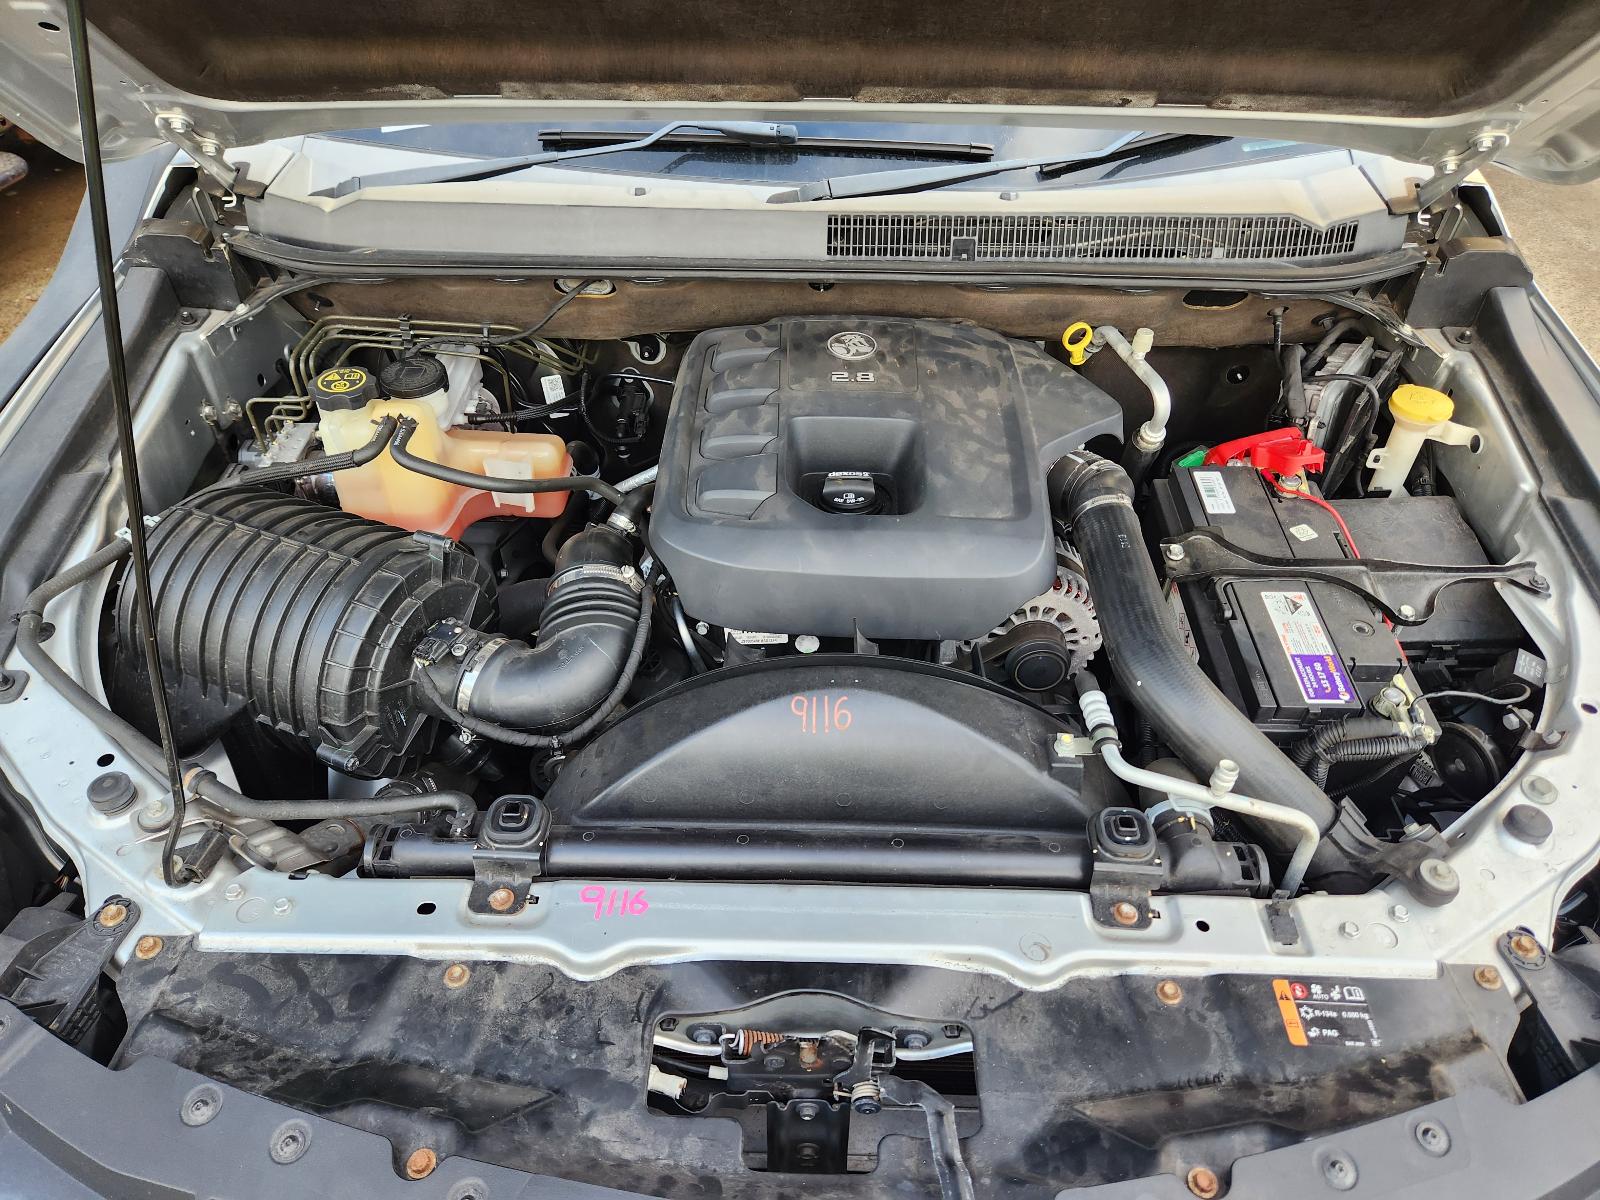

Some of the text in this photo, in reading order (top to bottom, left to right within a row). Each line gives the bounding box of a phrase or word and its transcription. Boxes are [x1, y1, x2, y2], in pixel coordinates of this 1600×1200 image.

[831, 371, 875, 382] 2.8
[791, 695, 852, 734] 9116
[579, 885, 650, 921] 9116
[1313, 993, 1330, 1001] AUTO
[1322, 1029, 1340, 1038] PAG
